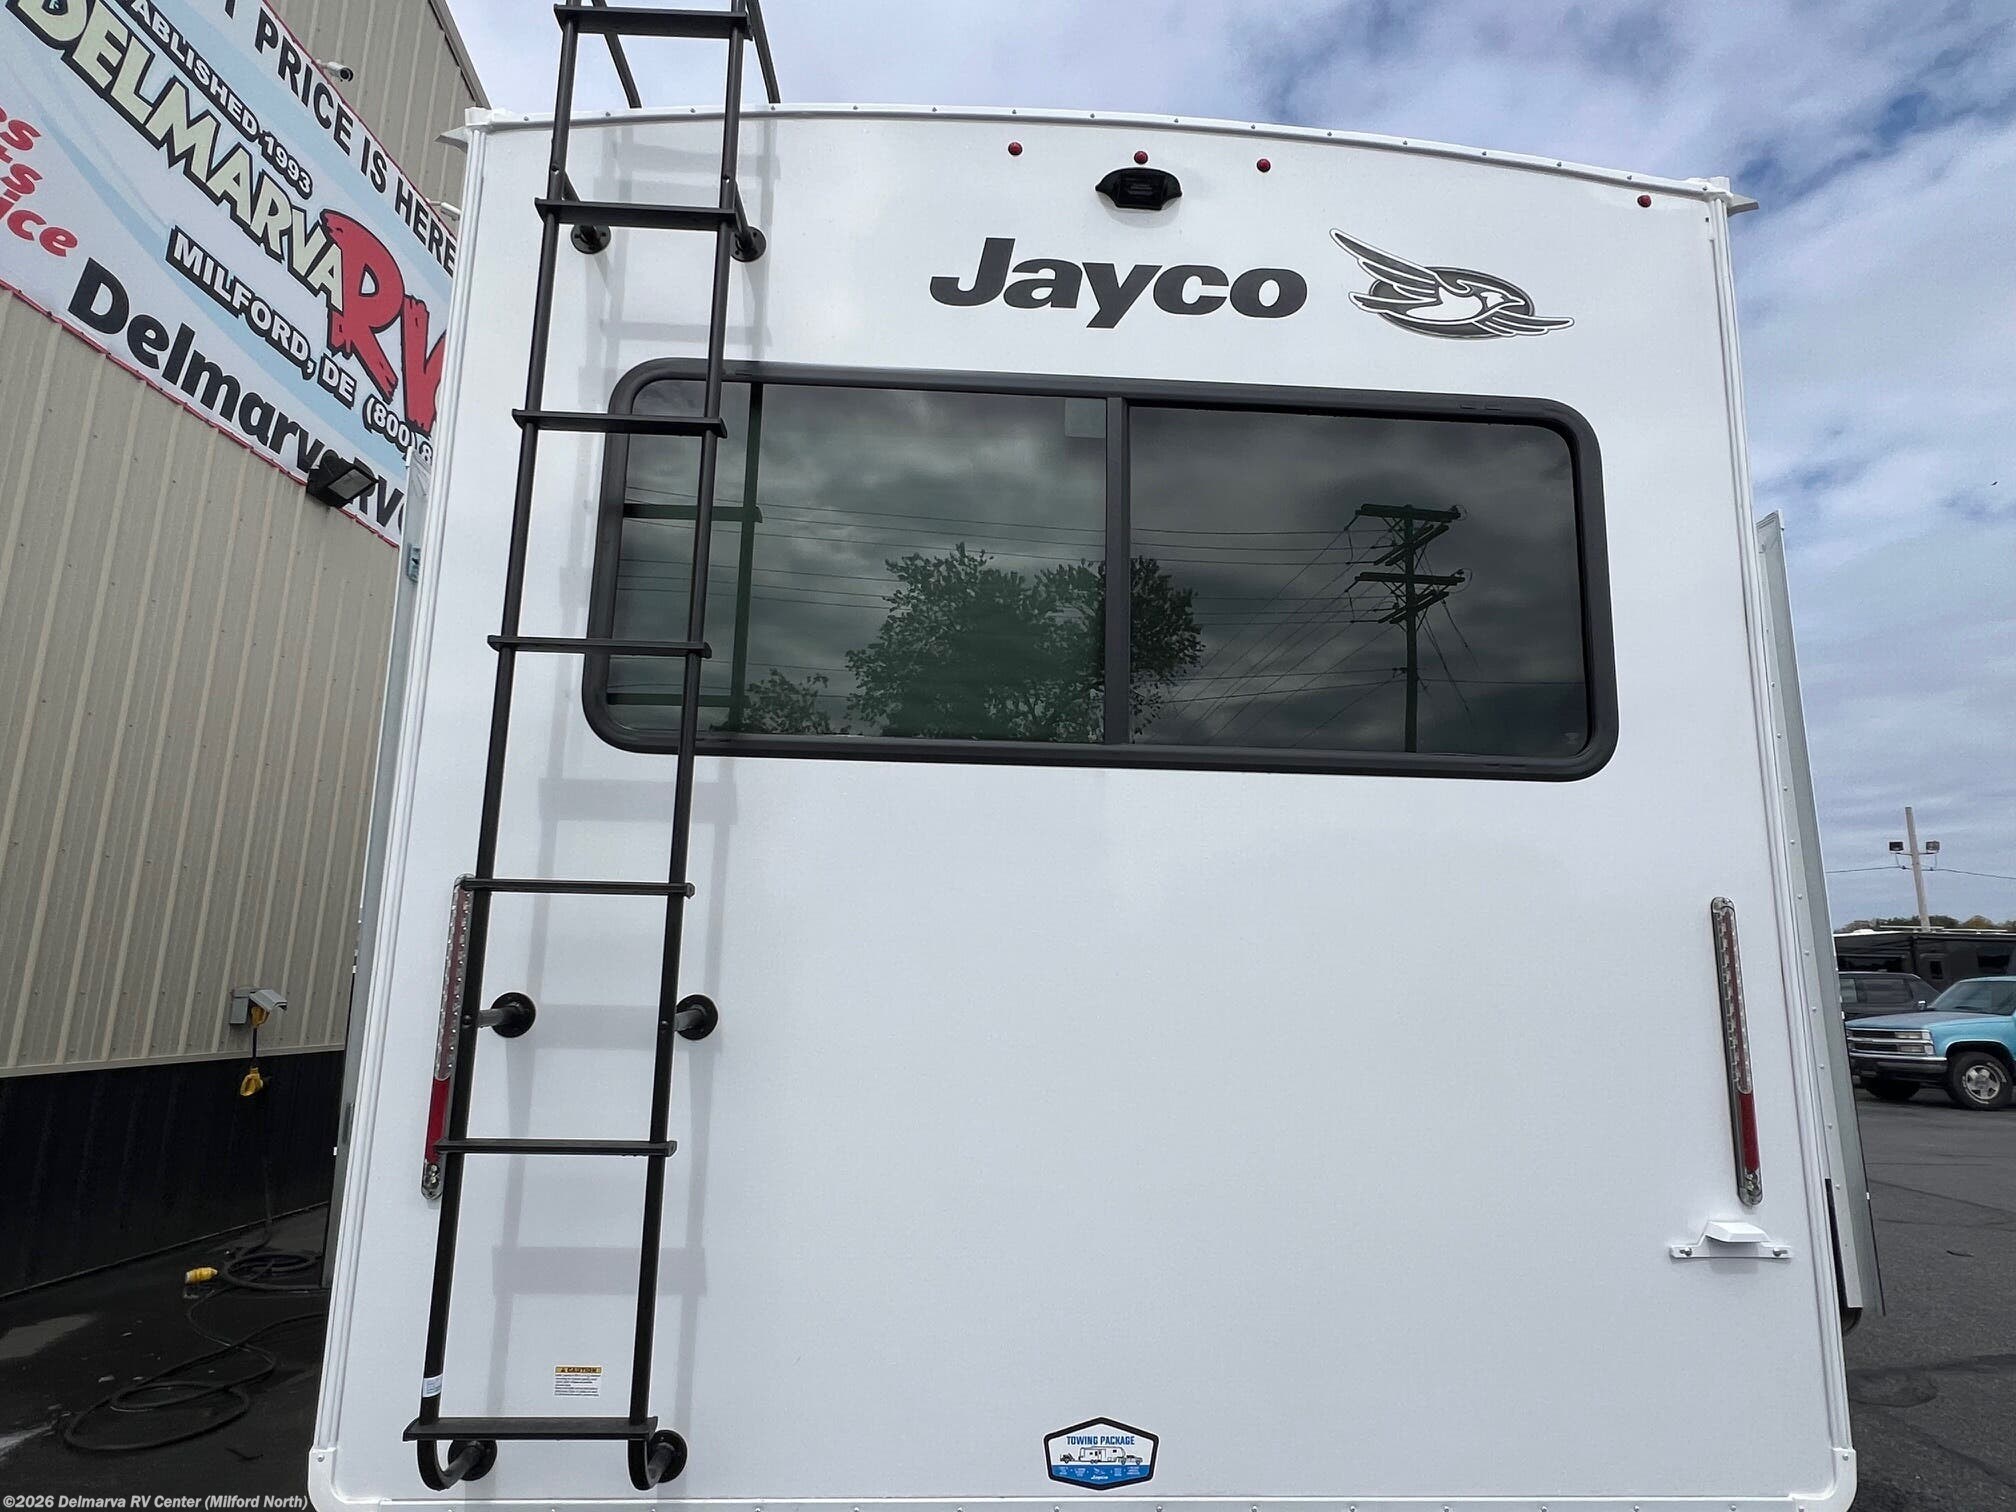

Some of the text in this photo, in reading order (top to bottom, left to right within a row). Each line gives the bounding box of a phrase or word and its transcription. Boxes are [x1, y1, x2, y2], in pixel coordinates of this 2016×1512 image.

[255, 7, 456, 276] PRICE IS HERE
[262, 133, 313, 195] 1993
[172, 231, 316, 376] MILFORD,
[320, 355, 356, 403] DE
[929, 237, 1308, 329] Jayco
[1066, 1436, 1135, 1445] TOWING PACKAGE
